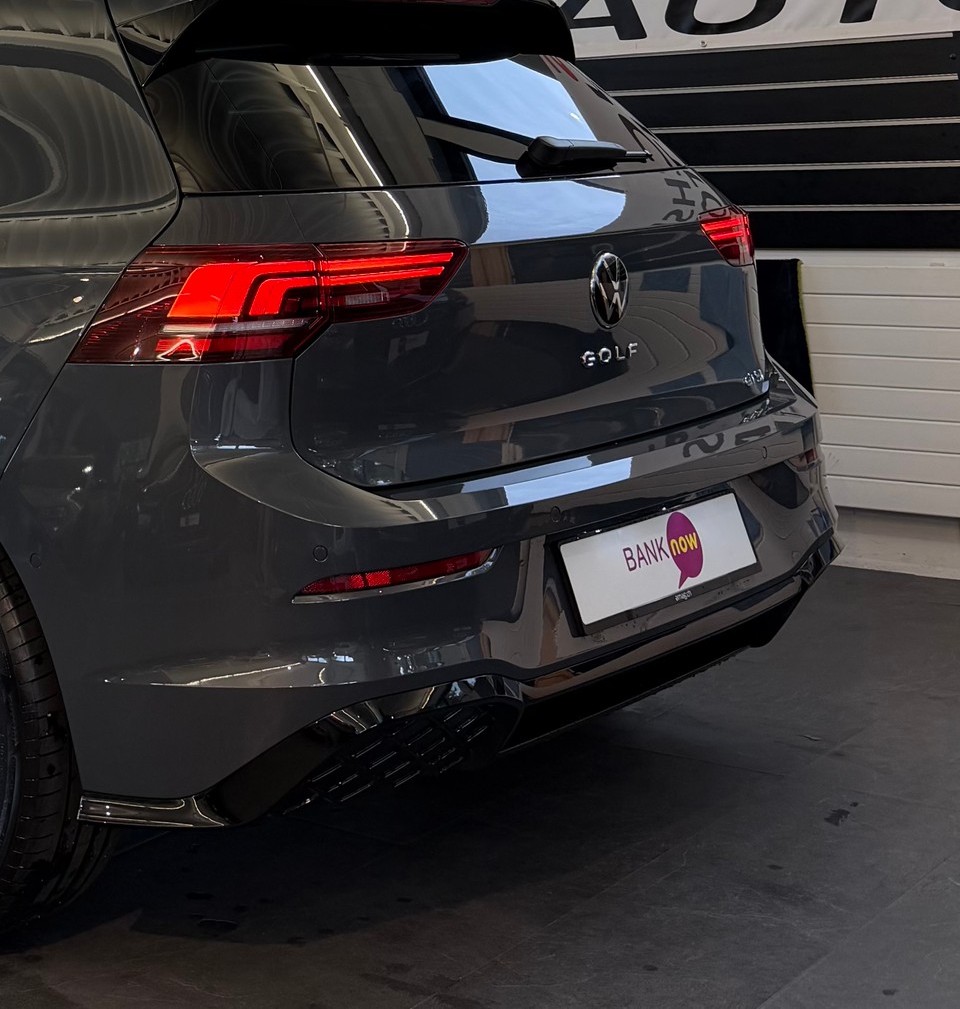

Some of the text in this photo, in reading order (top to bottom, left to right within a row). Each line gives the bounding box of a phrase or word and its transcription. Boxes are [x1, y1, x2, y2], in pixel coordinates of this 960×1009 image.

[580, 342, 639, 367] GOLF
[622, 532, 698, 572] BANK now
